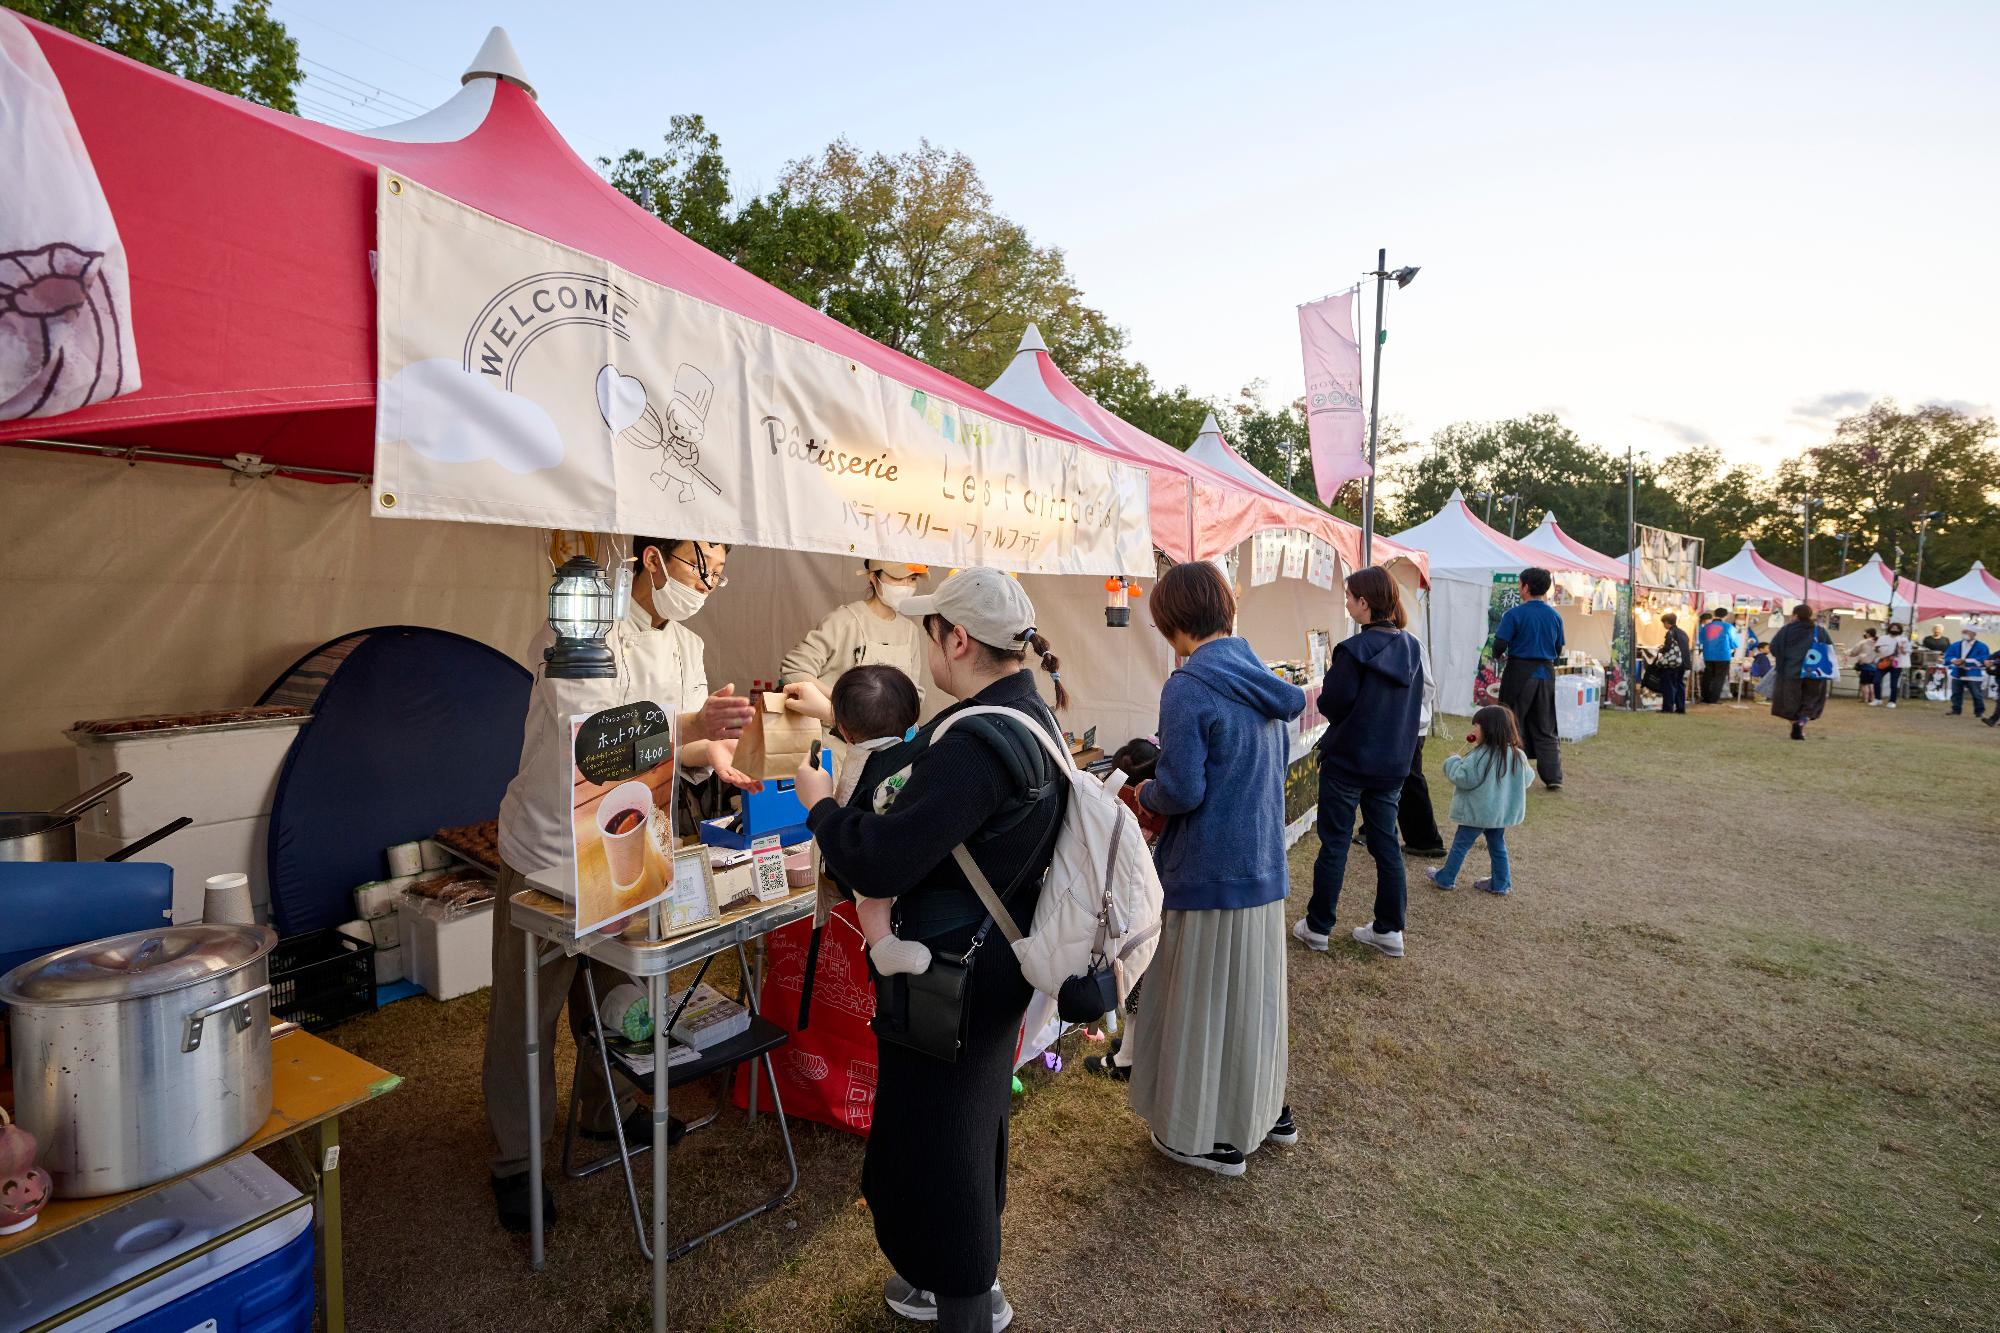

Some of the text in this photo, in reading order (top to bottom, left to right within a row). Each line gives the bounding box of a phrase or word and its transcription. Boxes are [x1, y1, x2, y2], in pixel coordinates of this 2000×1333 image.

[480, 285, 628, 378] WELCOME
[760, 415, 898, 482] Pâtisserie
[943, 453, 990, 506] Les
[843, 500, 949, 539] パティスリー
[597, 723, 652, 750] ホットワイン
